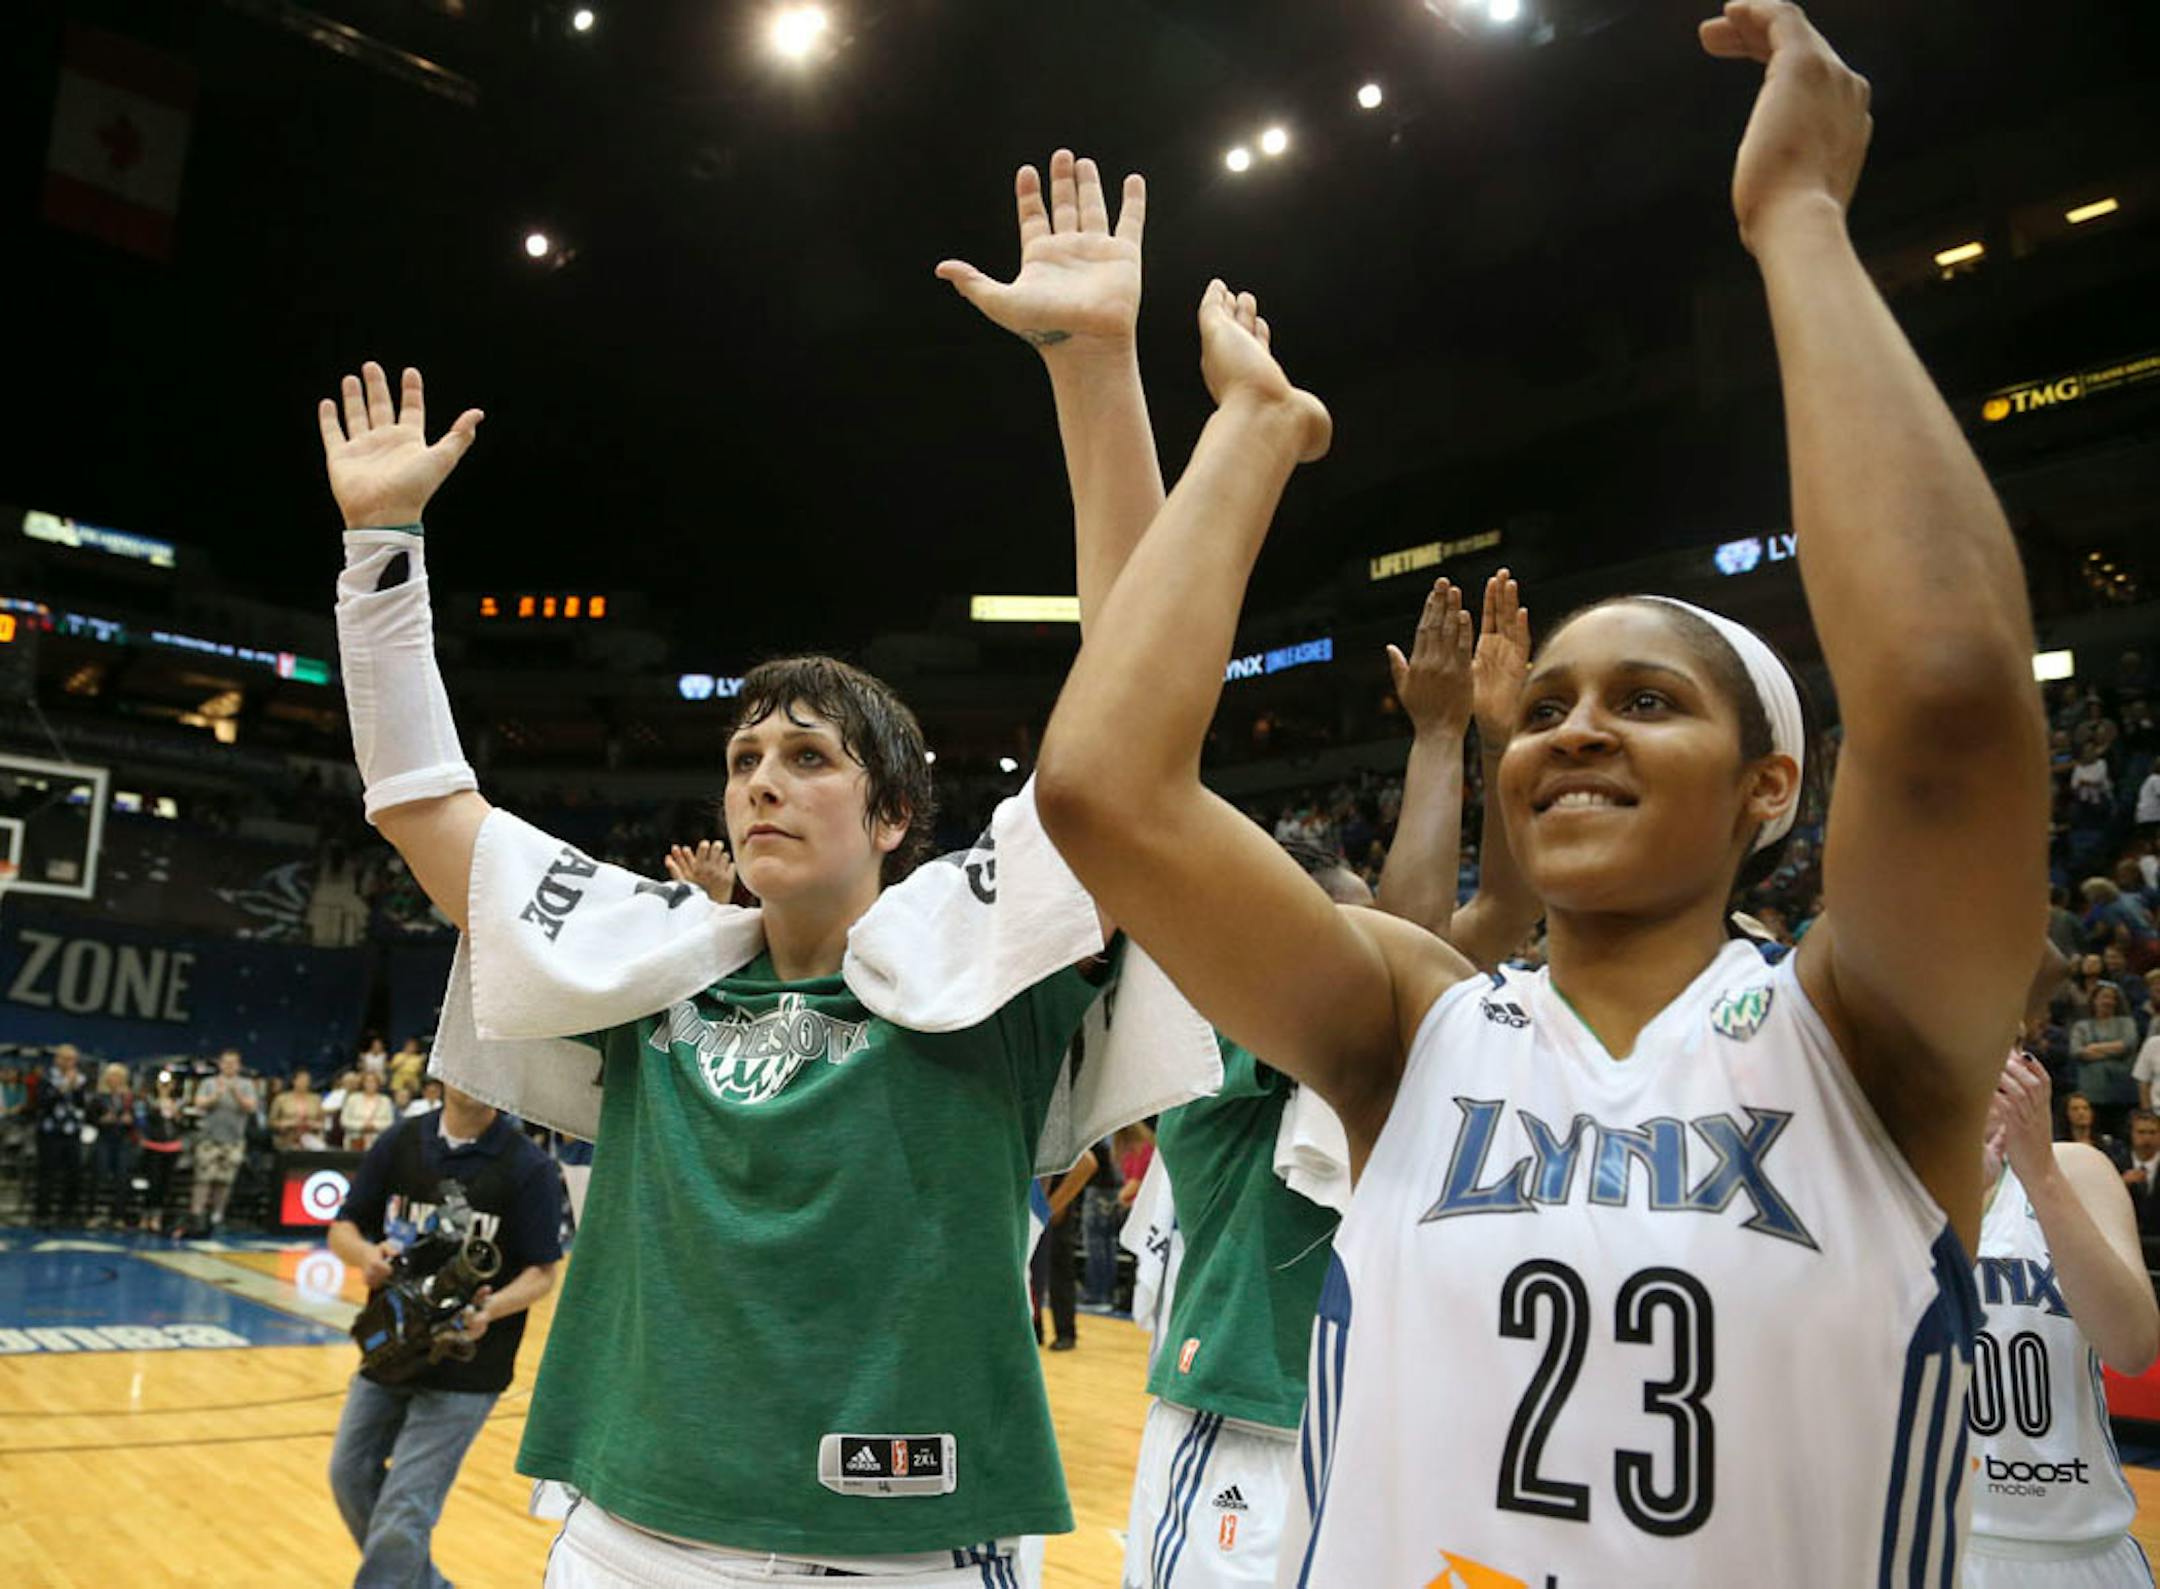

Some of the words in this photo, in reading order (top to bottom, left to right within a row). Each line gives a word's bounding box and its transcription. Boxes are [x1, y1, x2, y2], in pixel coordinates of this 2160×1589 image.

[2008, 376, 2080, 413] TMG
[1222, 653, 1264, 682] YNX
[7, 929, 196, 1023] ZONE
[1418, 1096, 1822, 1253] LYNX
[1496, 1257, 1715, 1538] 23
[1968, 1331, 2052, 1437] 00
[913, 1454, 939, 1468] 2XL
[1985, 1454, 2089, 1485] boost
[1987, 1482, 2047, 1498] mobile
